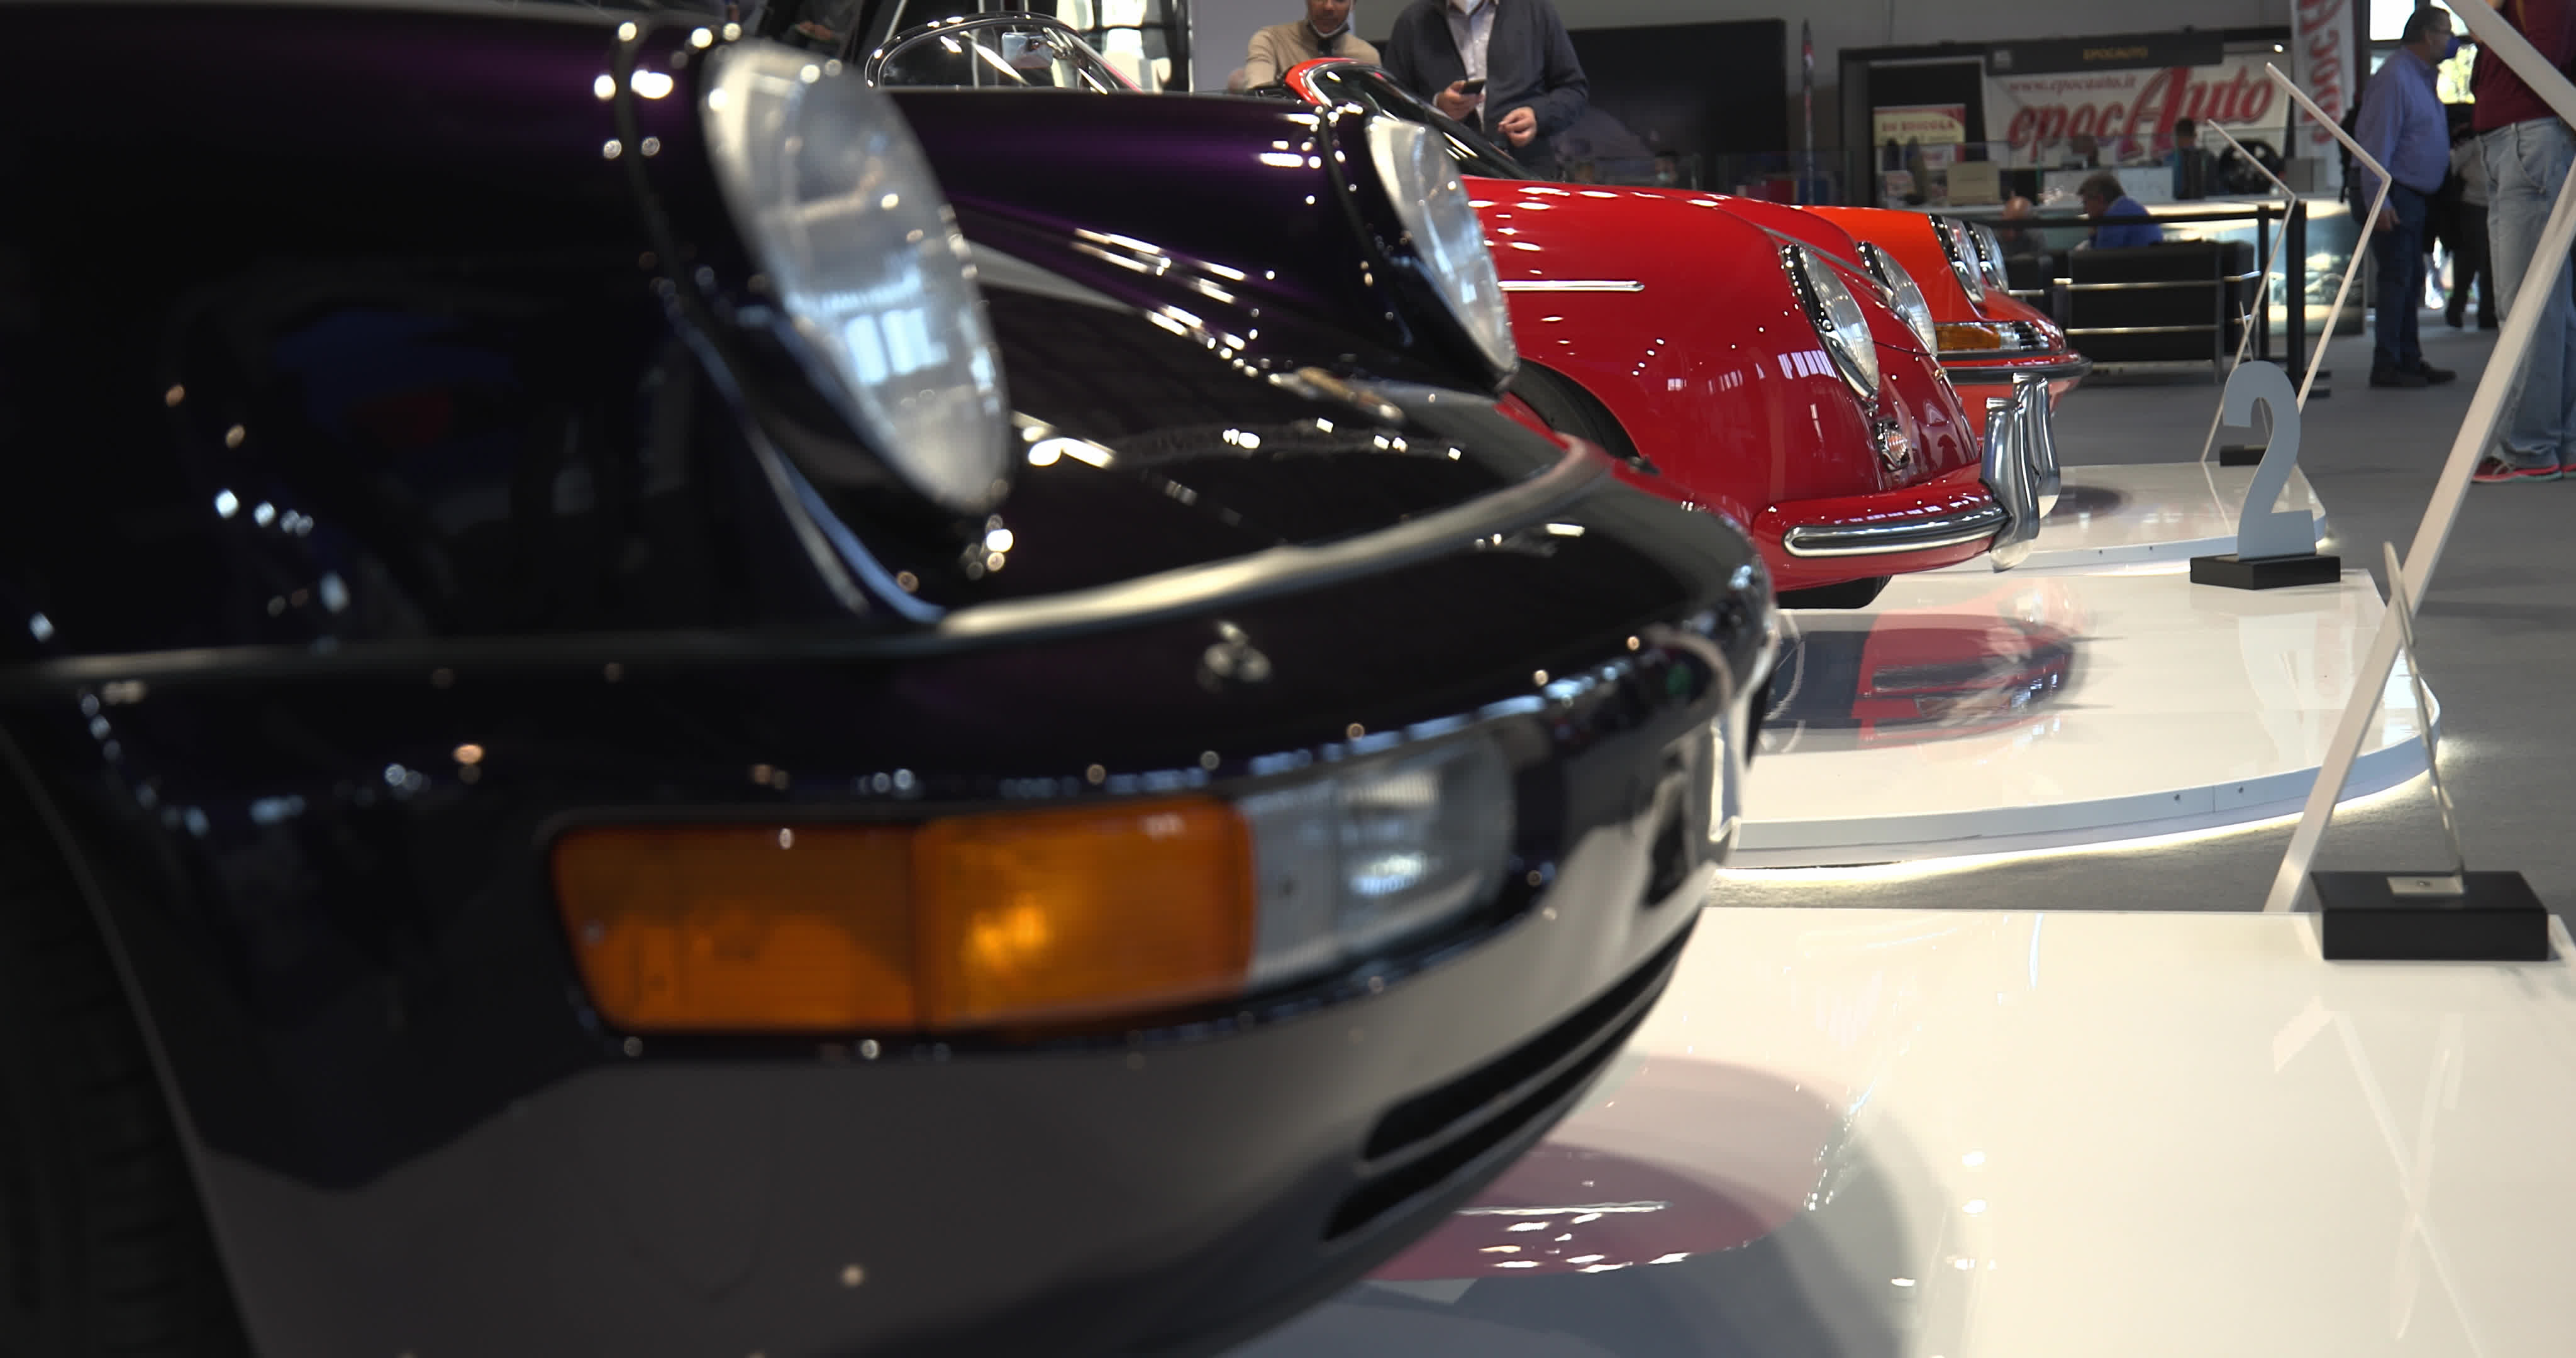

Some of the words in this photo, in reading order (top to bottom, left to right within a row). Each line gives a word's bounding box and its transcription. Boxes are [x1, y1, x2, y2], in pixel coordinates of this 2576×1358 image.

[2009, 72, 2137, 95] www.epocauto.it
[2083, 47, 2148, 61] EPOCAUTO
[2007, 65, 2275, 163] epocAuto
[2223, 360, 2316, 561] 2
